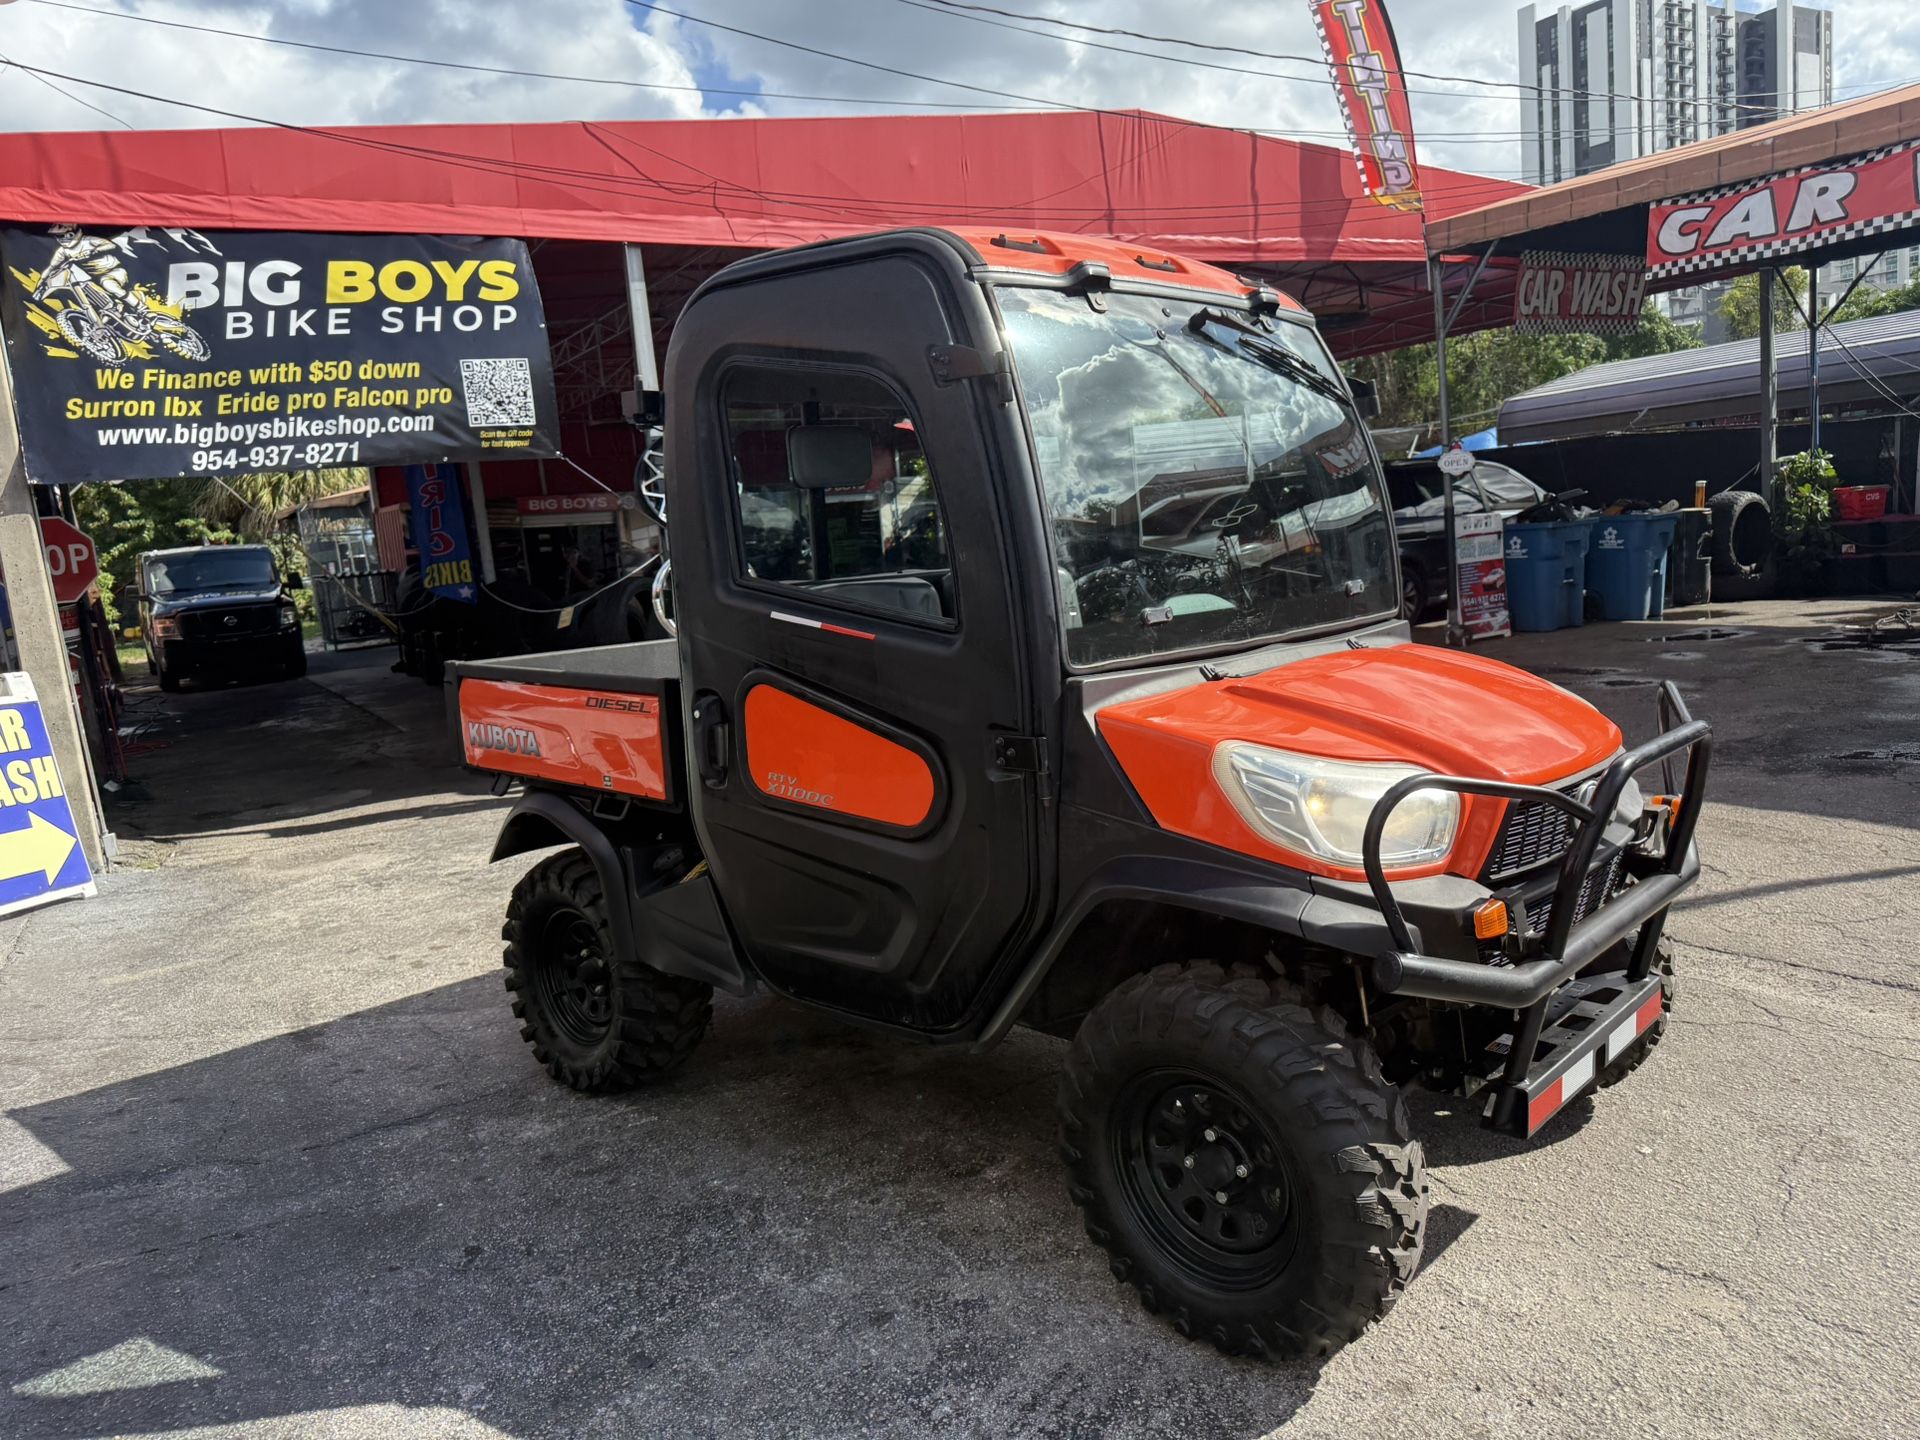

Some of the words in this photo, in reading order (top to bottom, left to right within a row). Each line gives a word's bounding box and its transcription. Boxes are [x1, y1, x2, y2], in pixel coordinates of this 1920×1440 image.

[1656, 170, 1858, 255] CAR
[167, 260, 303, 308] BIG
[326, 260, 519, 304] BOYS
[1519, 268, 1566, 316] CAR
[1569, 269, 1646, 315] WASH
[226, 308, 351, 340] BIKE
[381, 305, 517, 334] SHOP
[95, 368, 135, 390] We
[143, 368, 242, 390] Finance
[250, 363, 302, 385] with
[309, 360, 352, 384] $50
[359, 359, 421, 380] down
[65, 397, 155, 420] Surron
[217, 391, 280, 415] Eride
[287, 391, 326, 414] pro
[334, 387, 408, 408] Falcon
[416, 387, 453, 409] pro
[98, 415, 435, 448] www.bigboysbikeshop.com
[192, 441, 360, 471] 954-937-8271
[528, 498, 559, 511] BIG
[562, 497, 608, 509] BOYS
[585, 696, 652, 714] DIESEL
[468, 721, 541, 757] KUBOTA
[767, 771, 797, 785] RTV
[767, 782, 834, 806] X1100C
